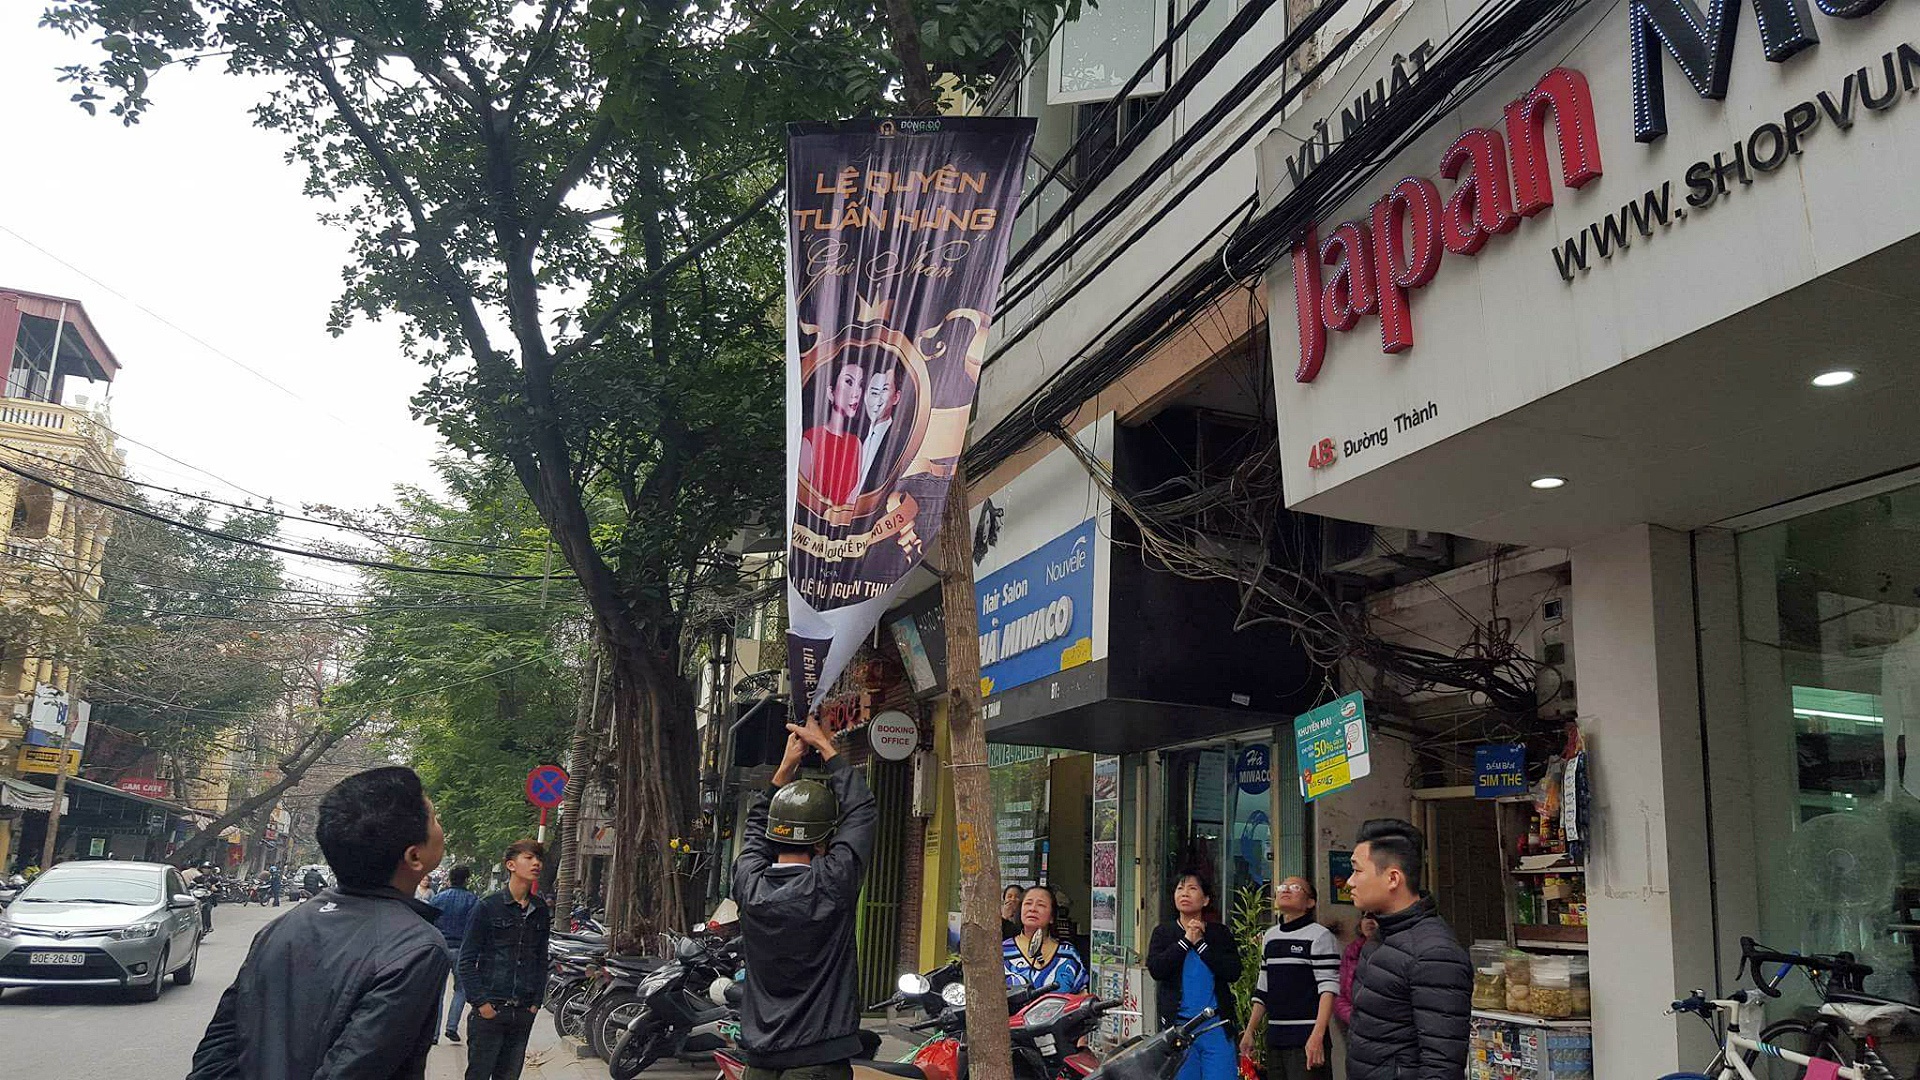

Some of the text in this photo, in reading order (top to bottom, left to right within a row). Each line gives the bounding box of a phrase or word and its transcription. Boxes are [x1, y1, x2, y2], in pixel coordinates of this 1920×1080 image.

[815, 164, 988, 200] LỆ QUYÊN
[793, 197, 999, 232] TUẤN HƯNG
[1292, 66, 1603, 384] Japan
[1308, 401, 1438, 469] 4B Đường Thành
[885, 513, 905, 530] 8/3
[983, 579, 1028, 615] Hair Salon
[1000, 595, 1074, 660] MIWACO
[877, 724, 915, 746] BOOKING OFFICE
[1479, 774, 1499, 787] SIM
